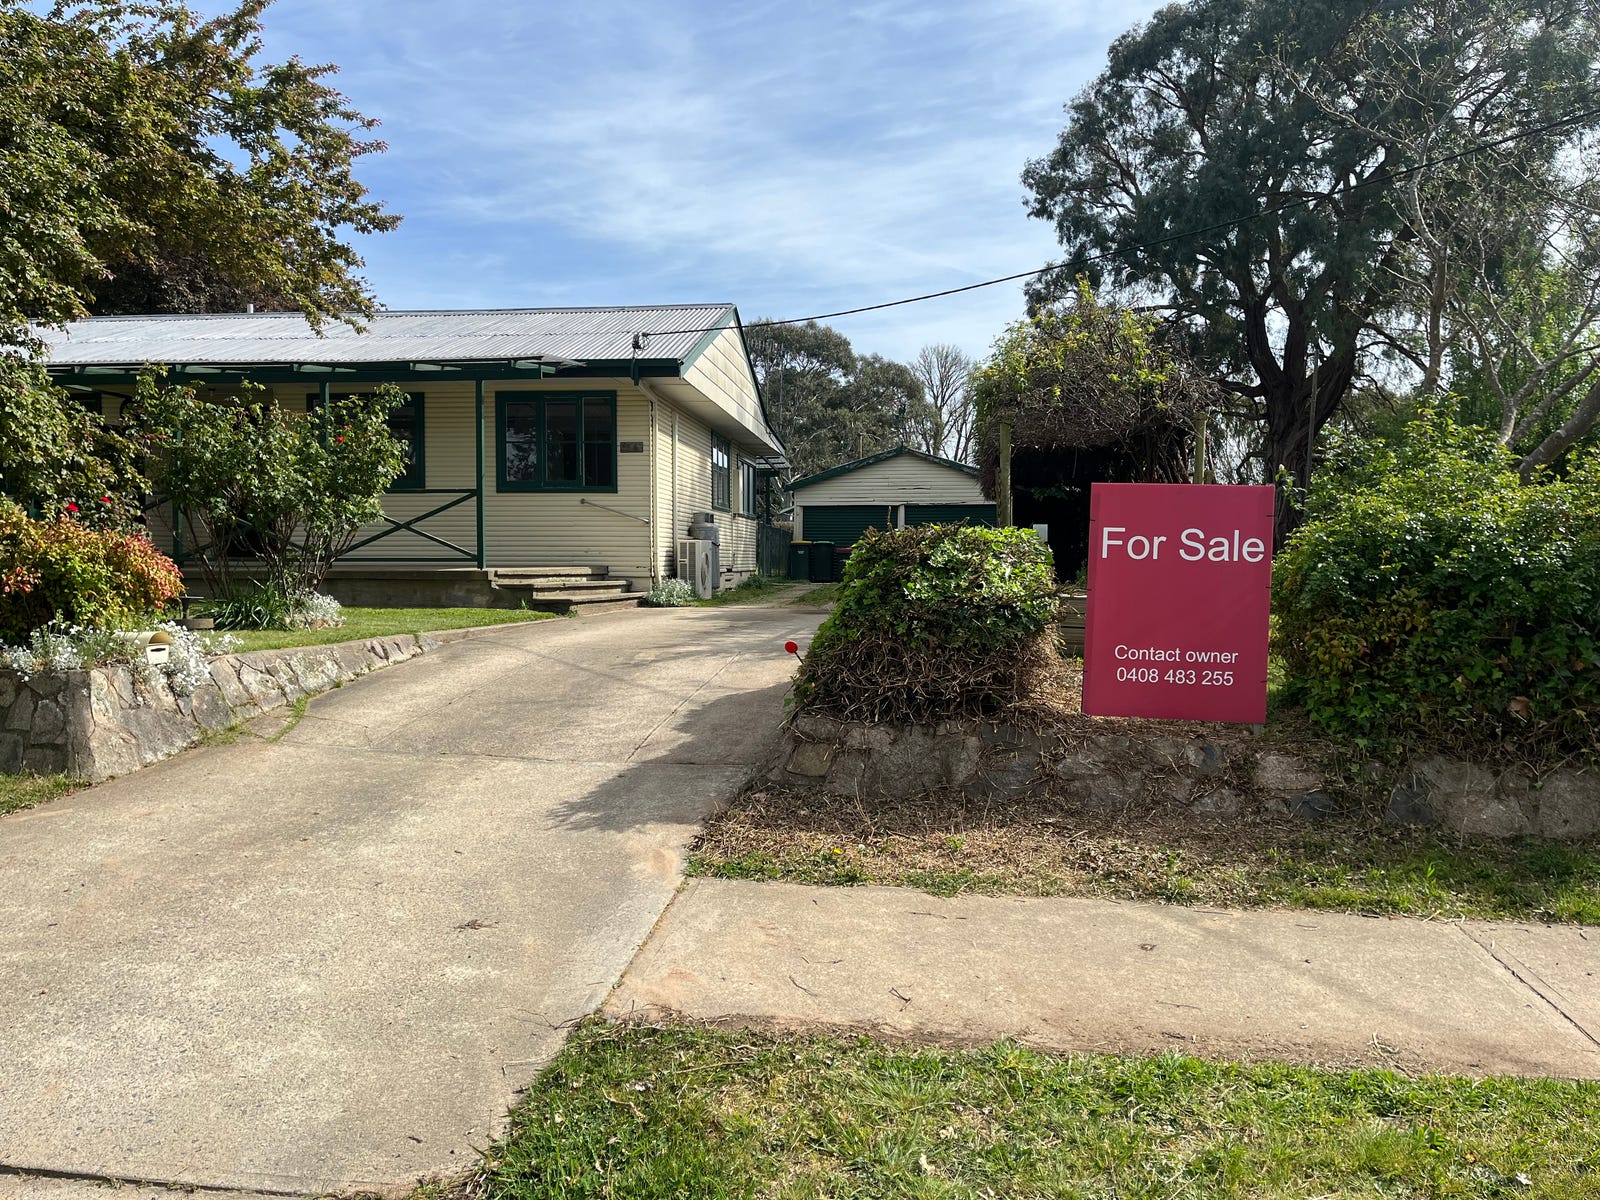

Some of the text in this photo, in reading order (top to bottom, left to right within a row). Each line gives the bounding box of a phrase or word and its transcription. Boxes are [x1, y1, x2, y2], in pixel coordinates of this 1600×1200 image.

[1101, 527, 1265, 563] For Sale
[1114, 644, 1239, 664] Contact owner
[1116, 667, 1234, 686] 0408 483 255
